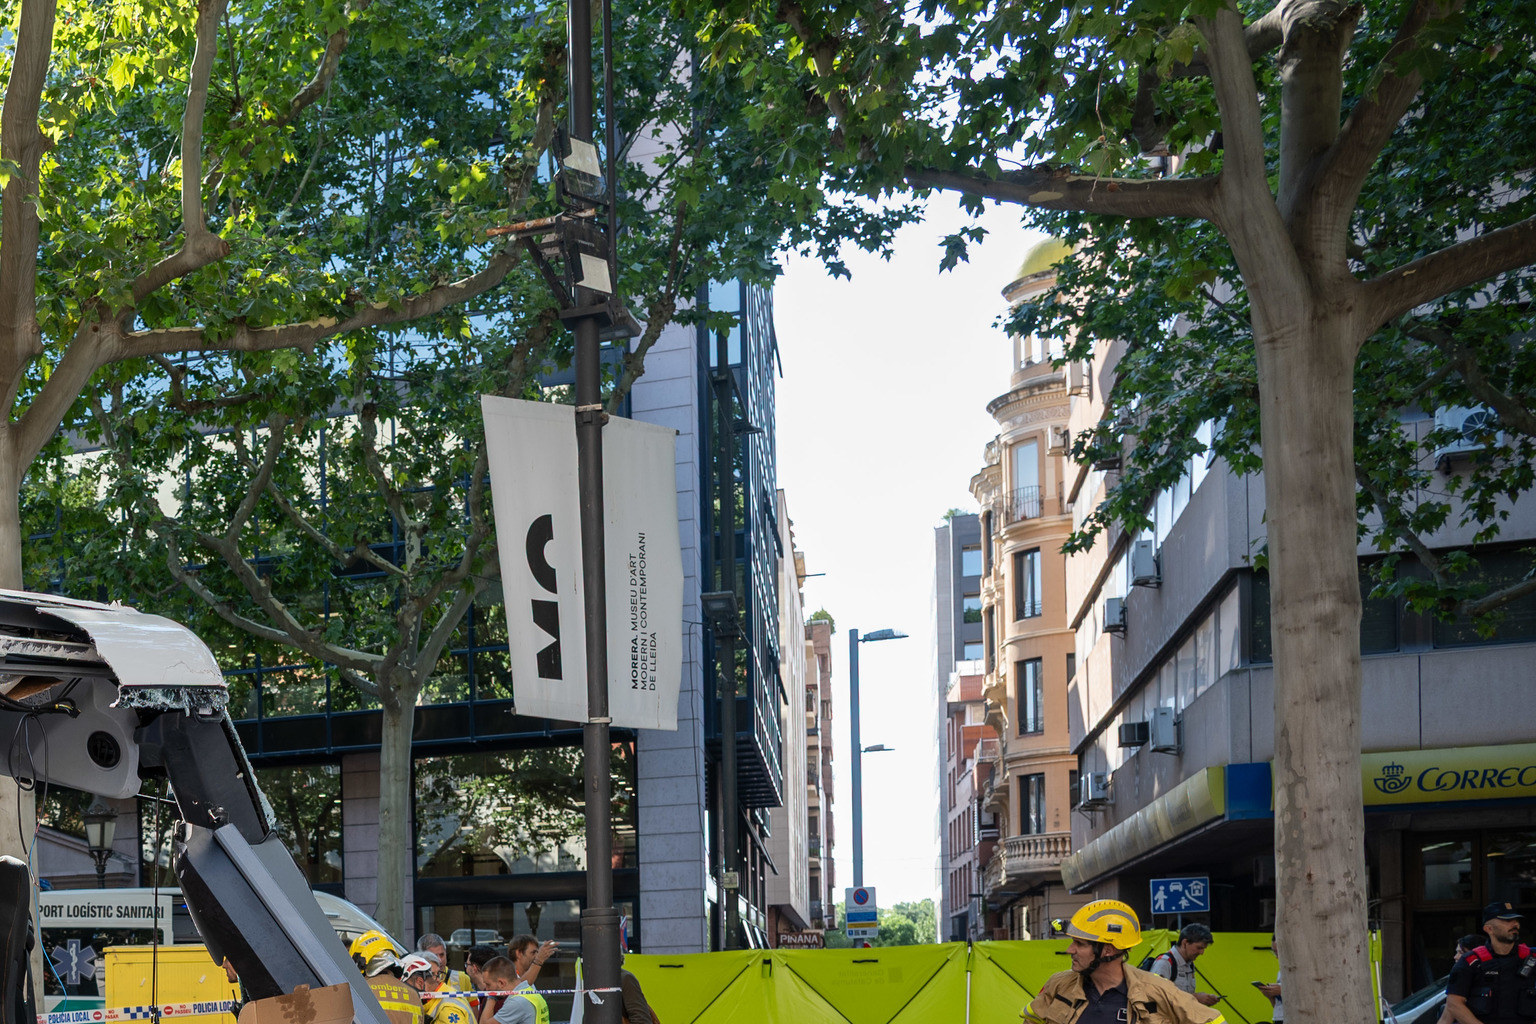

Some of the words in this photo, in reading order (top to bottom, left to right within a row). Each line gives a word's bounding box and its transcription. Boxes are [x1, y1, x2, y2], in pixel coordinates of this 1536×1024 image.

[629, 553, 637, 586] D'ART
[638, 532, 648, 629] CONTEMPORANI
[630, 590, 638, 631] MUSEU
[631, 635, 639, 690] MORERA.
[640, 638, 648, 690] MODERN
[649, 631, 657, 672] LLEIDA
[649, 676, 657, 691] DE
[66, 902, 113, 918] LOGÍSTIC
[48, 1012, 70, 1024] POLICIA
[72, 1011, 90, 1022] LOCAL
[193, 1002, 218, 1014] POLICIA
